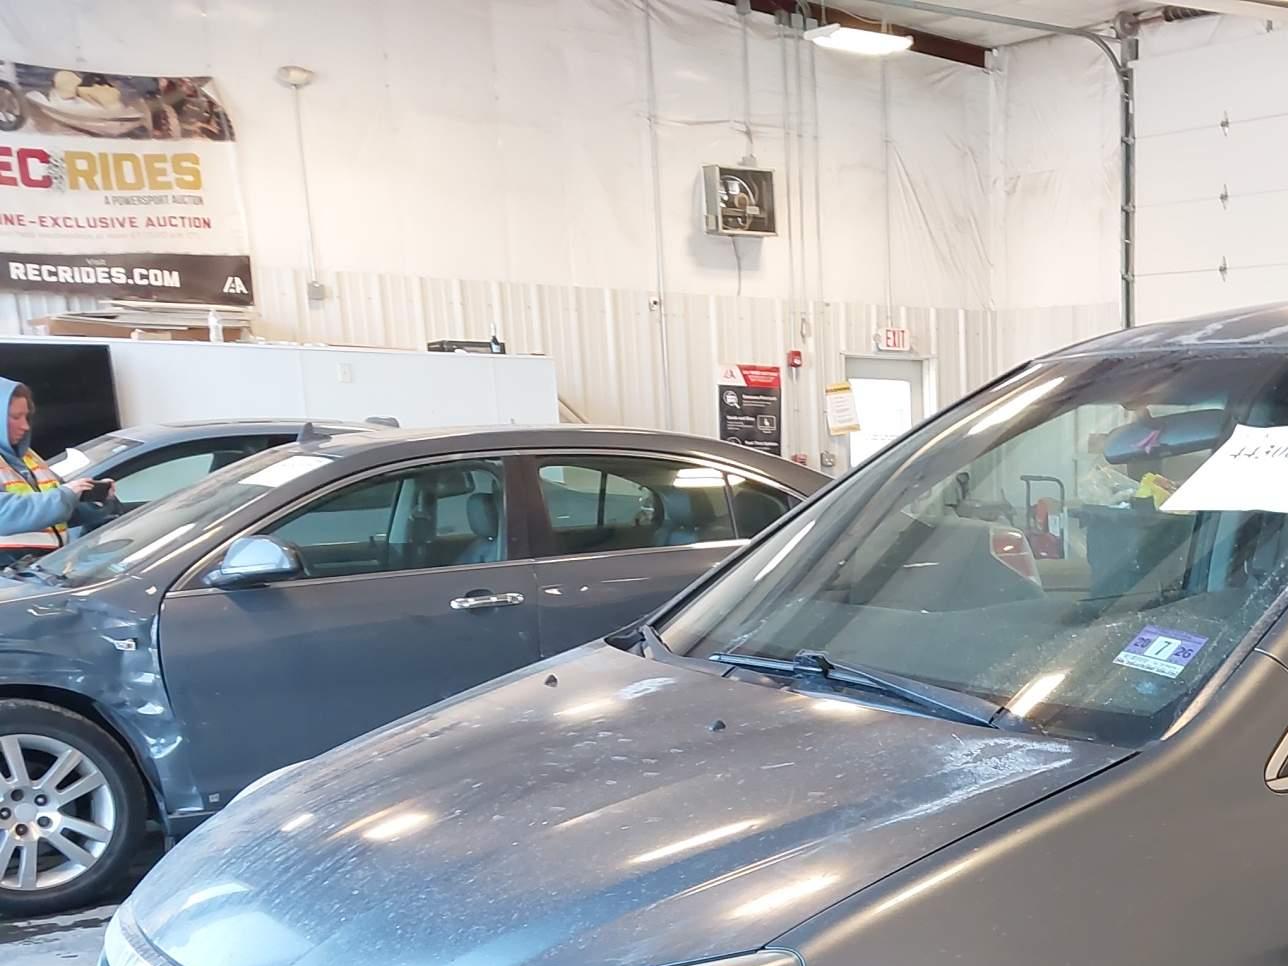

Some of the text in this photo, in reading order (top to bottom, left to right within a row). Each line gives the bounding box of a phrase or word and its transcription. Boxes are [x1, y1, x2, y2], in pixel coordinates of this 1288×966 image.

[64, 150, 202, 191] RIDES
[112, 195, 169, 206] POWERSPORT
[172, 195, 204, 206] AUCTION
[145, 216, 212, 229] AUCTION
[8, 261, 181, 288] RECRIDES.COM
[885, 329, 905, 348] EXIT
[1134, 637, 1194, 659] 20 7 26
